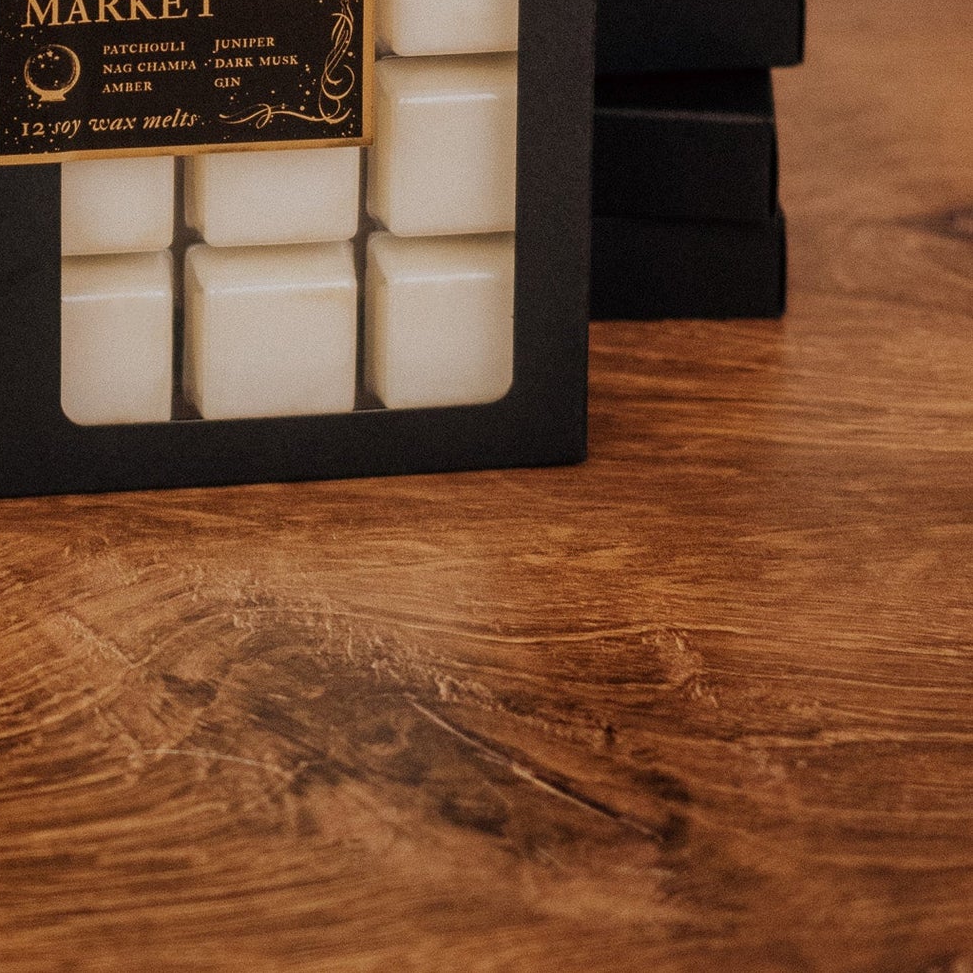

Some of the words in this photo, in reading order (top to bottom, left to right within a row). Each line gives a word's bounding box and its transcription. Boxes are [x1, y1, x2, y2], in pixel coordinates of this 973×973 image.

[103, 41, 186, 55] PATCHOULI
[213, 36, 275, 53] JUNIPER
[103, 63, 132, 74] NAG
[137, 60, 197, 73] CHAMPA
[215, 57, 254, 69] DARK
[259, 55, 299, 67] MUSK
[102, 81, 153, 93] AMBER
[214, 77, 242, 88] GIN
[21, 122, 45, 137] 12
[52, 117, 82, 139] soy
[89, 116, 137, 131] wax
[143, 108, 197, 128] melts
